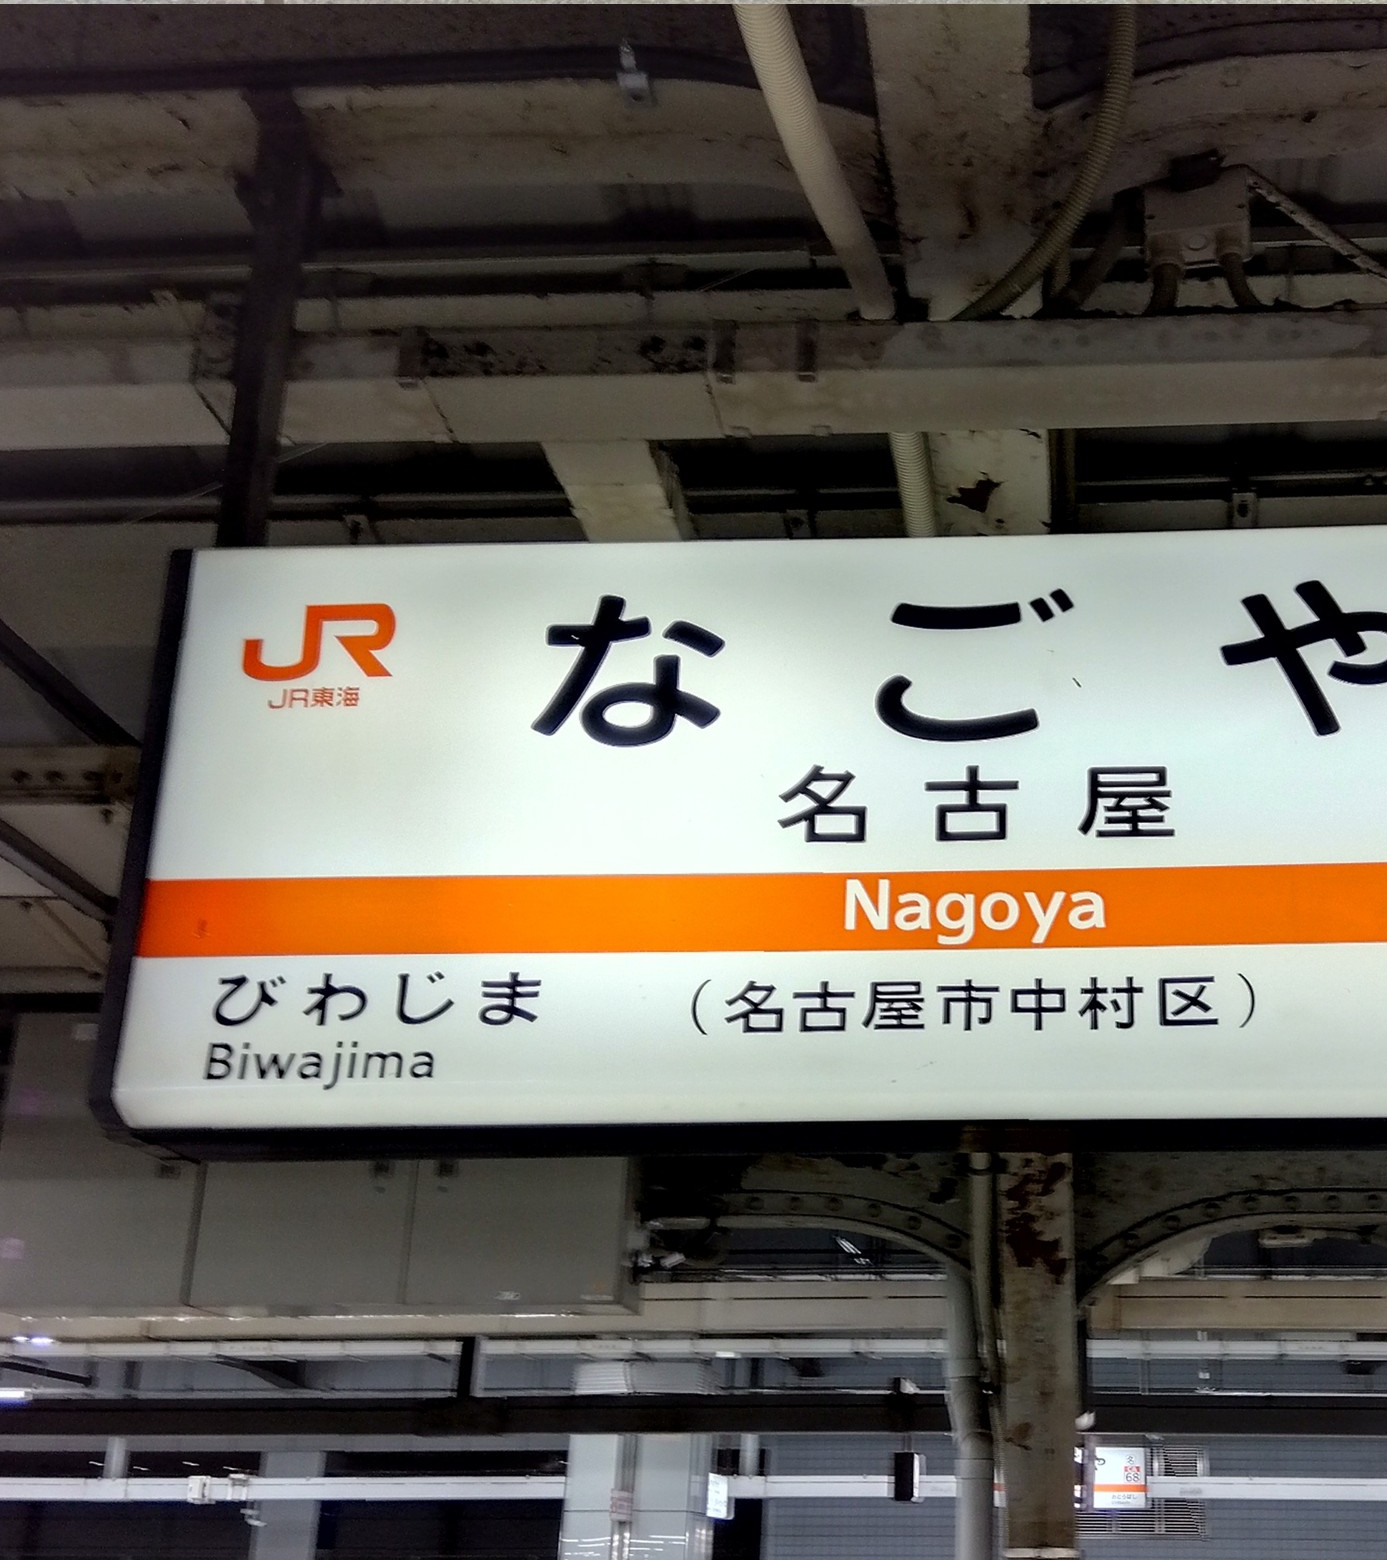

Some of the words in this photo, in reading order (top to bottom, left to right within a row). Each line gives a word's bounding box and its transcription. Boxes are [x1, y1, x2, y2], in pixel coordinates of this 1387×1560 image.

[239, 602, 397, 682] JR
[267, 686, 361, 709] JR東海
[777, 765, 1175, 843] 名古屋
[843, 878, 1107, 945] Nagoya
[213, 971, 542, 1028] びわじま
[203, 1040, 436, 1092] Biwajima
